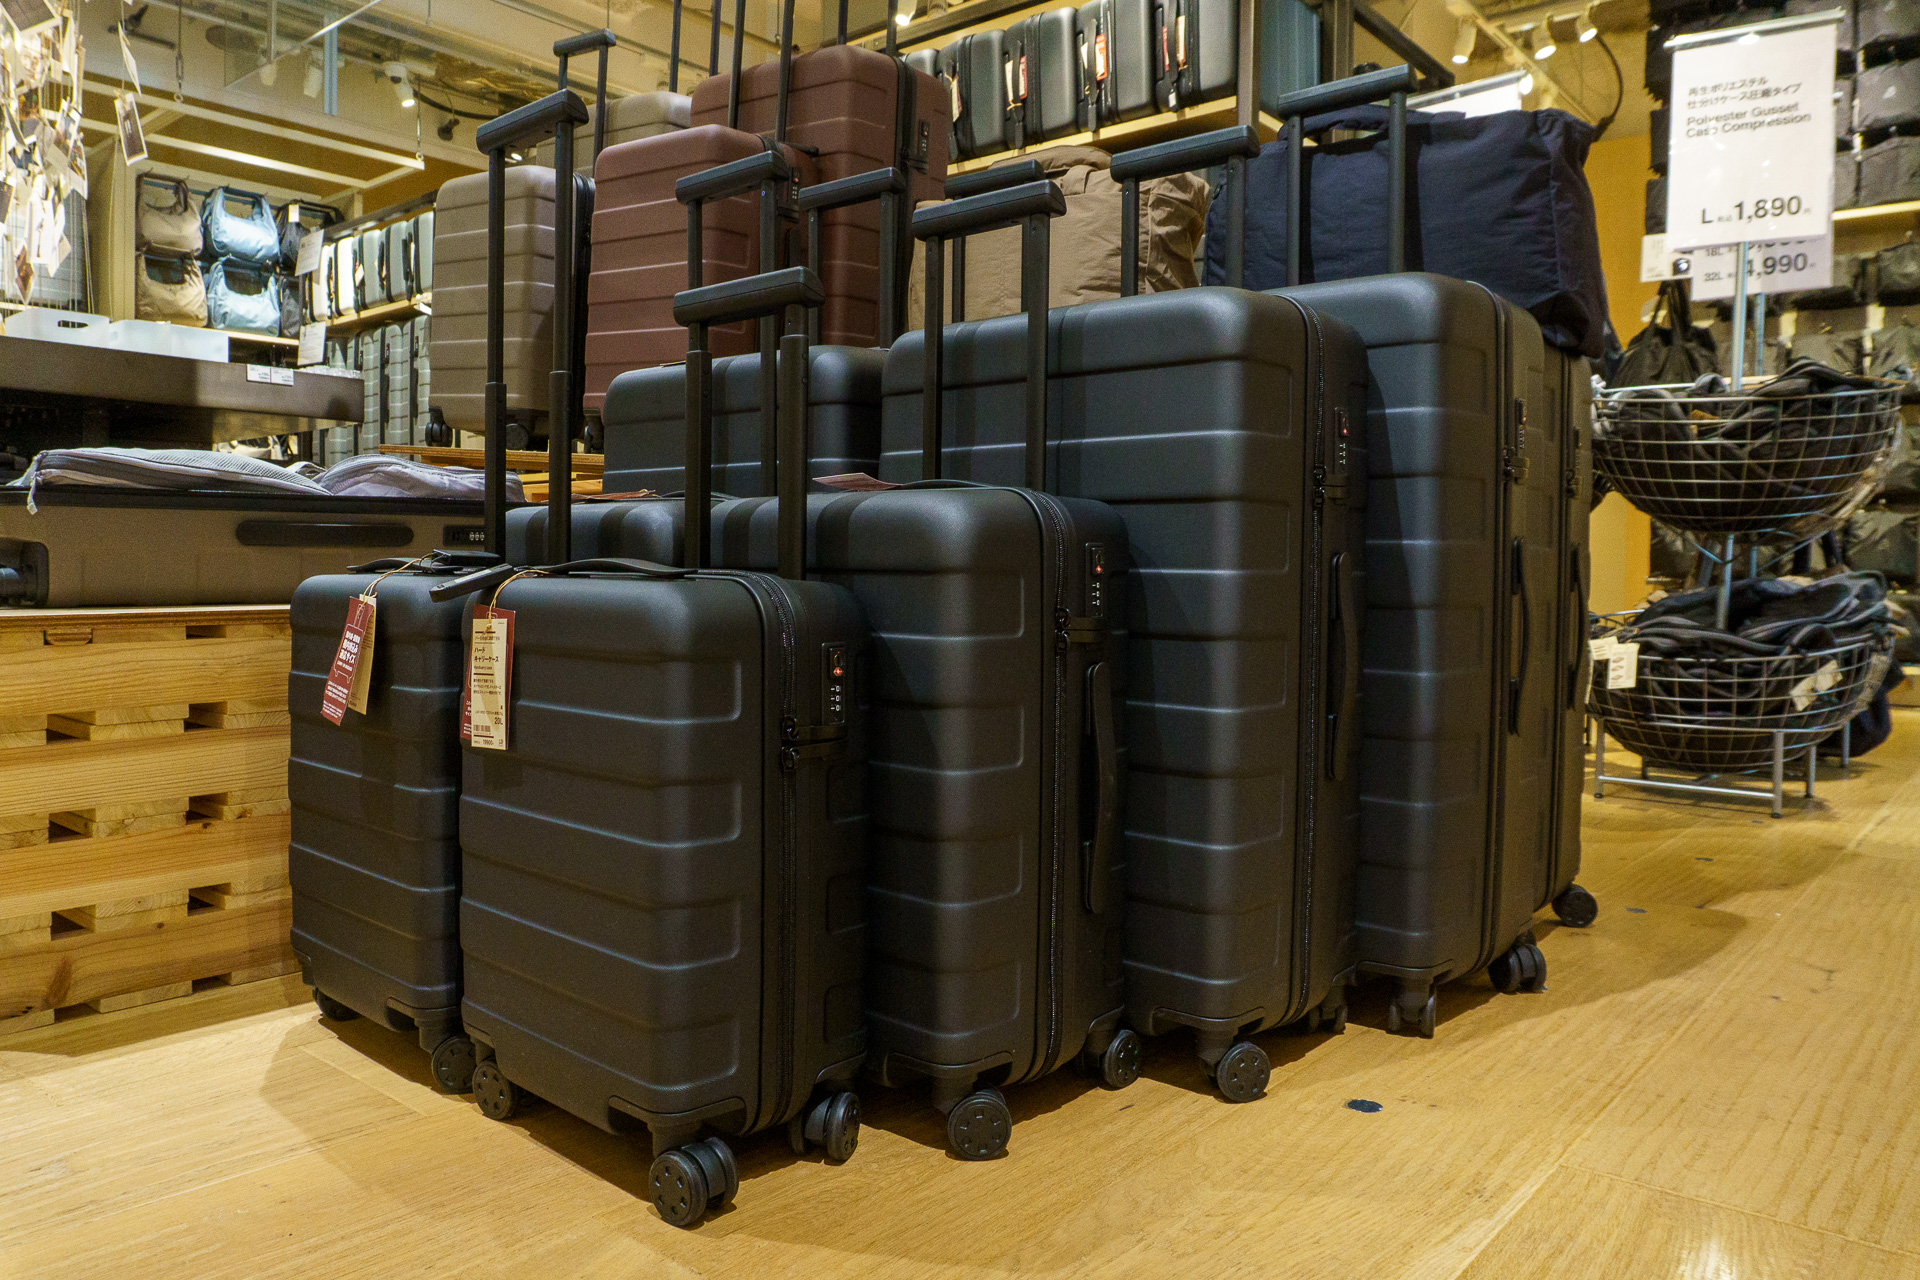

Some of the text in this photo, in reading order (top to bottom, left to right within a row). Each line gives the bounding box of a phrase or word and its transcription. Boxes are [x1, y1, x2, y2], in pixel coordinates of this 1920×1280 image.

[1688, 76, 1768, 96] 再生ポリエステル
[1687, 102, 1799, 126] Polyester Gusset
[1722, 113, 1811, 133] Compression
[1701, 208, 1713, 224] L
[1734, 195, 1803, 223] 1,890
